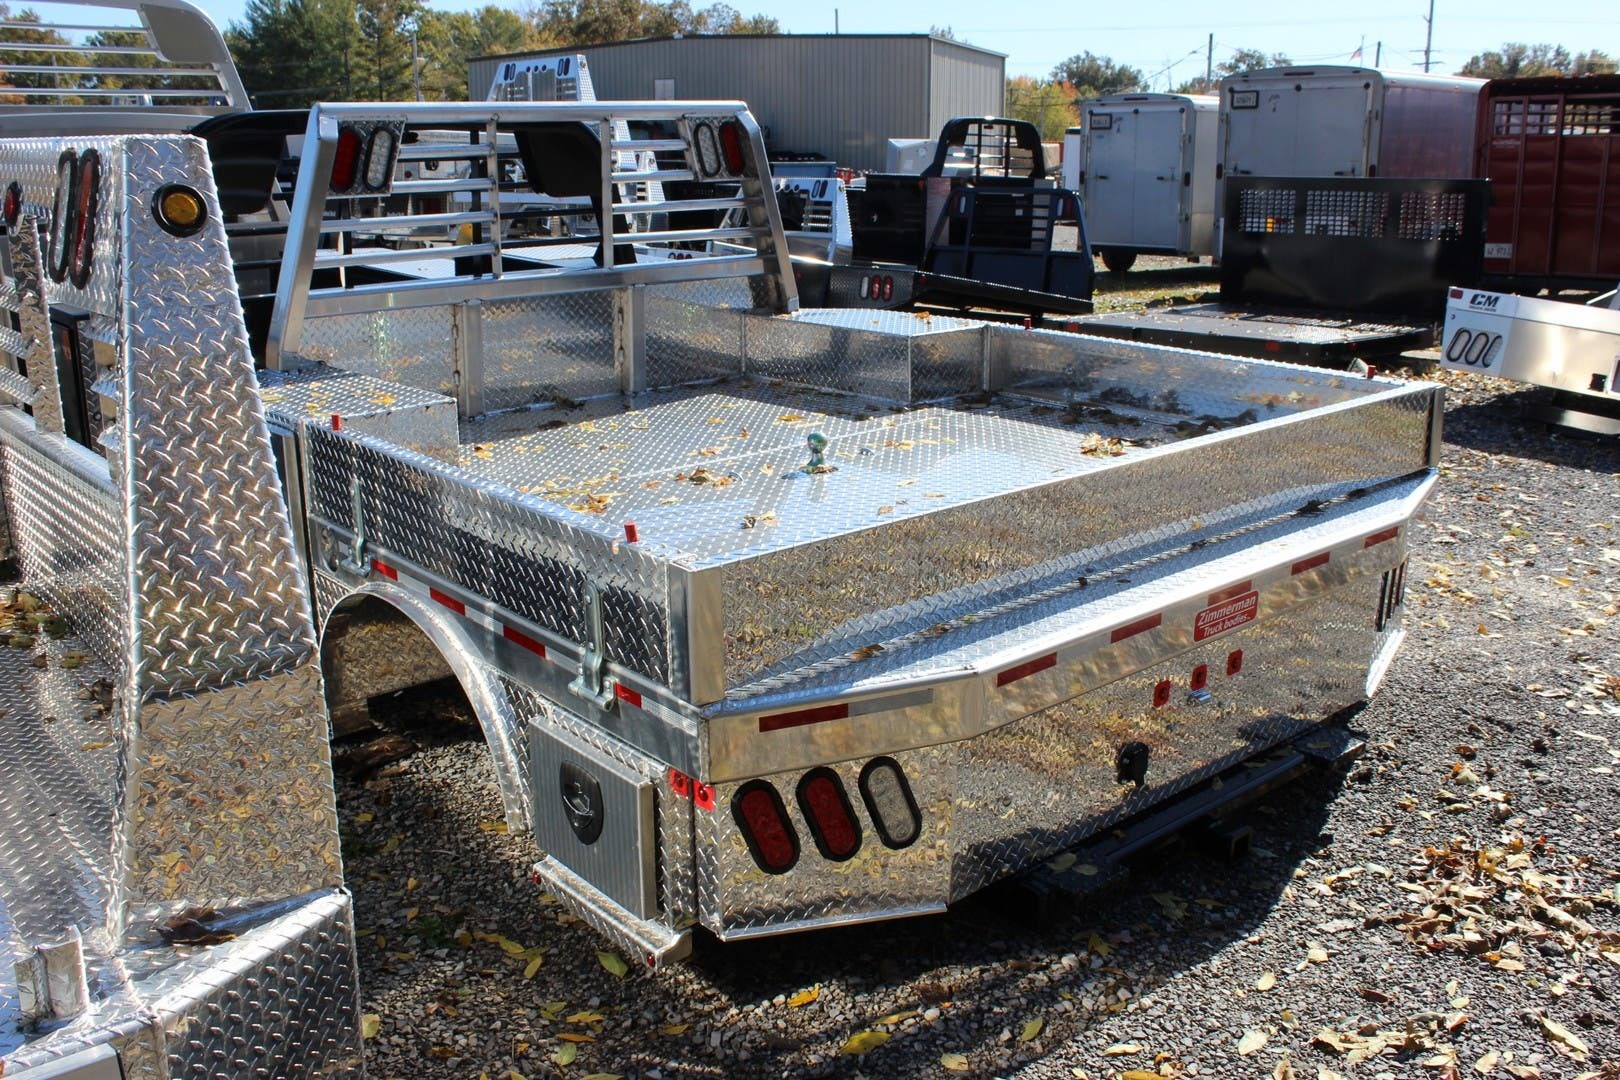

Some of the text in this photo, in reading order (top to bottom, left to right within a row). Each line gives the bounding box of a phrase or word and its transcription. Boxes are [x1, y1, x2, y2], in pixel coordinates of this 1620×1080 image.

[1470, 293, 1500, 307] CM
[1198, 595, 1256, 626] Zimmerman
[1203, 622, 1223, 637] Truck
